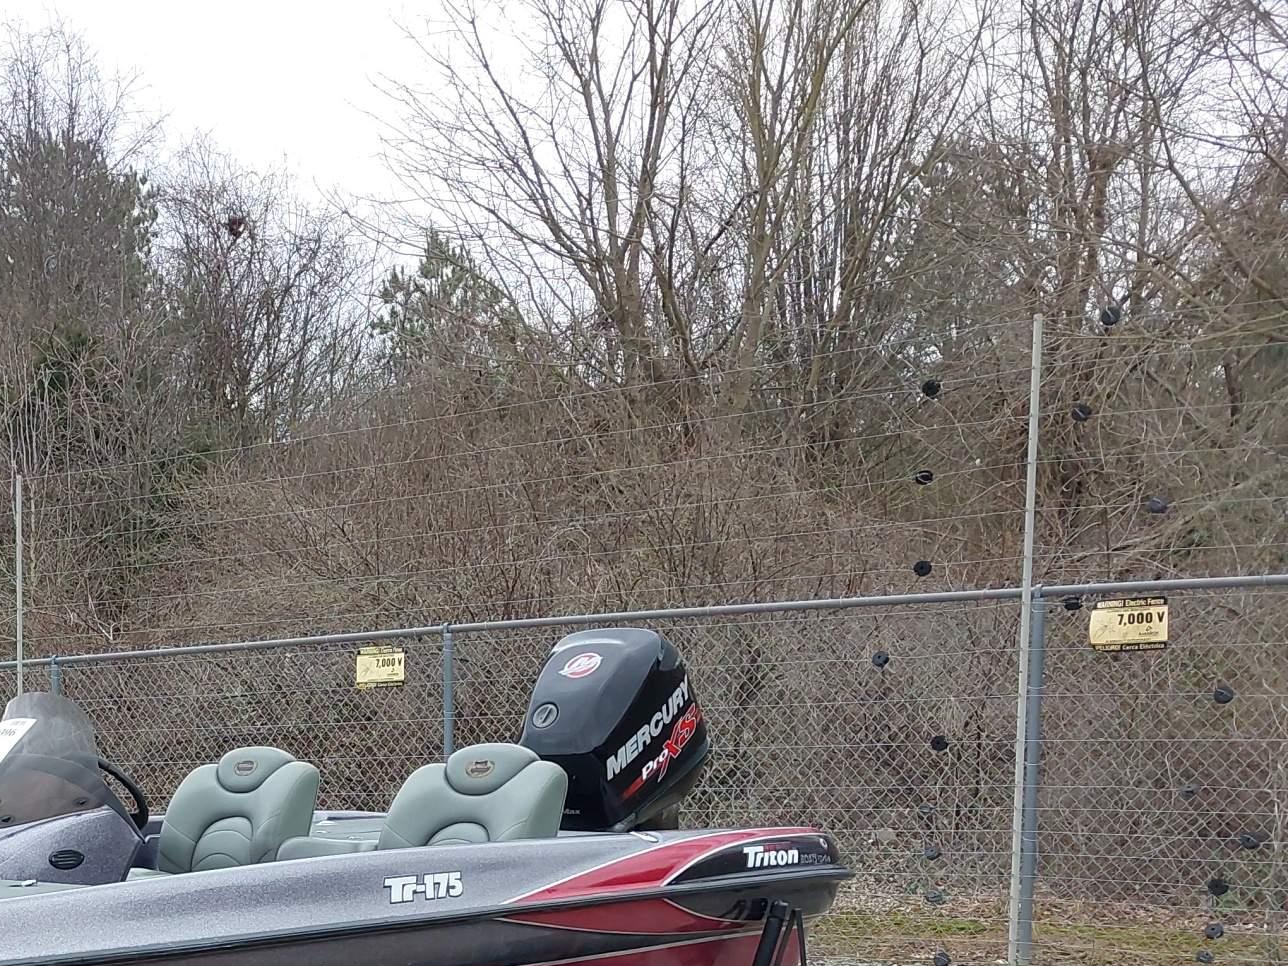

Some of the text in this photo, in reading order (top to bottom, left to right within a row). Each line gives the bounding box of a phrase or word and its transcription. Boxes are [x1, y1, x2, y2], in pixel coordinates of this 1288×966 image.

[1117, 611, 1165, 626] 7,000 V
[397, 657, 403, 667] V
[606, 674, 689, 781] MERCURY
[743, 845, 799, 868] Triton
